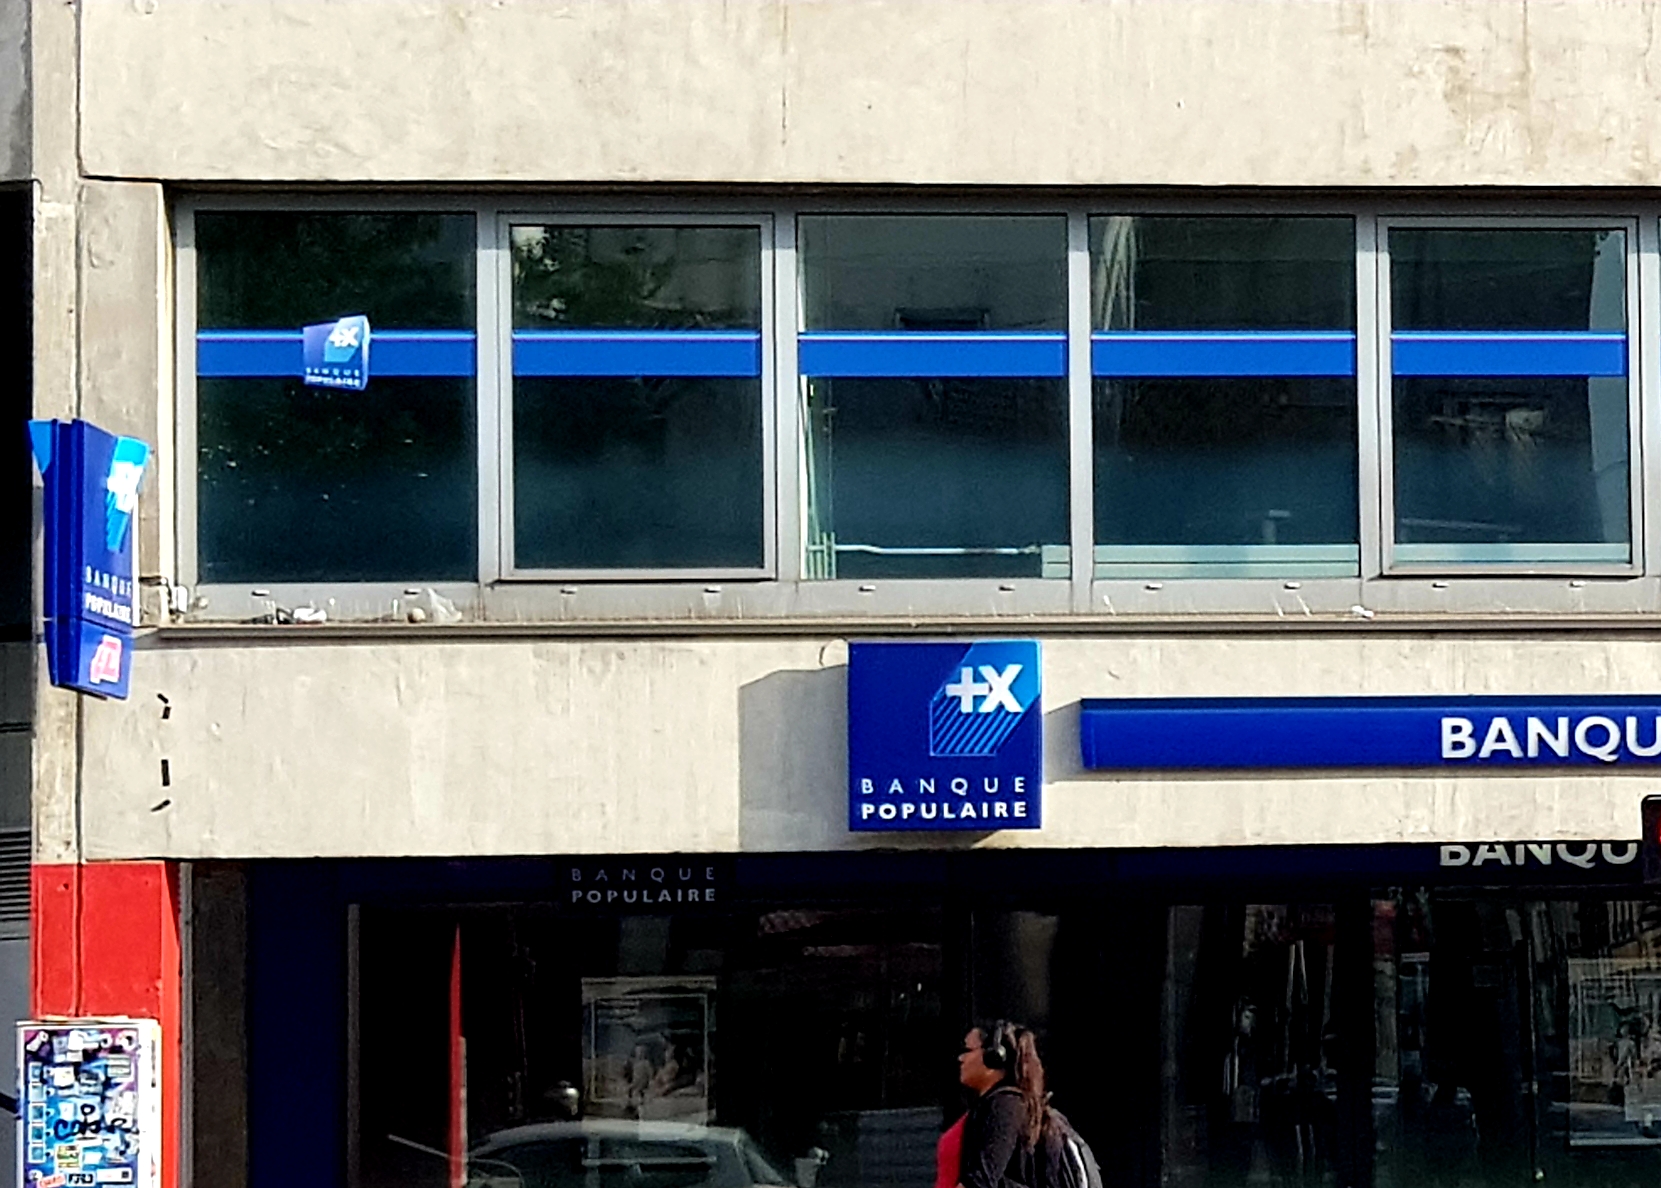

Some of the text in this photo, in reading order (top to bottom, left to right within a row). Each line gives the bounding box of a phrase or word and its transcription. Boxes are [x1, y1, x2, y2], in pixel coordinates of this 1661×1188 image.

[861, 777, 1025, 796] BANQUE
[862, 801, 1027, 820] POPULAIRE
[1439, 842, 1638, 869] BANQU
[571, 866, 715, 883] BANQUE
[571, 888, 716, 903] POPULAIRE
